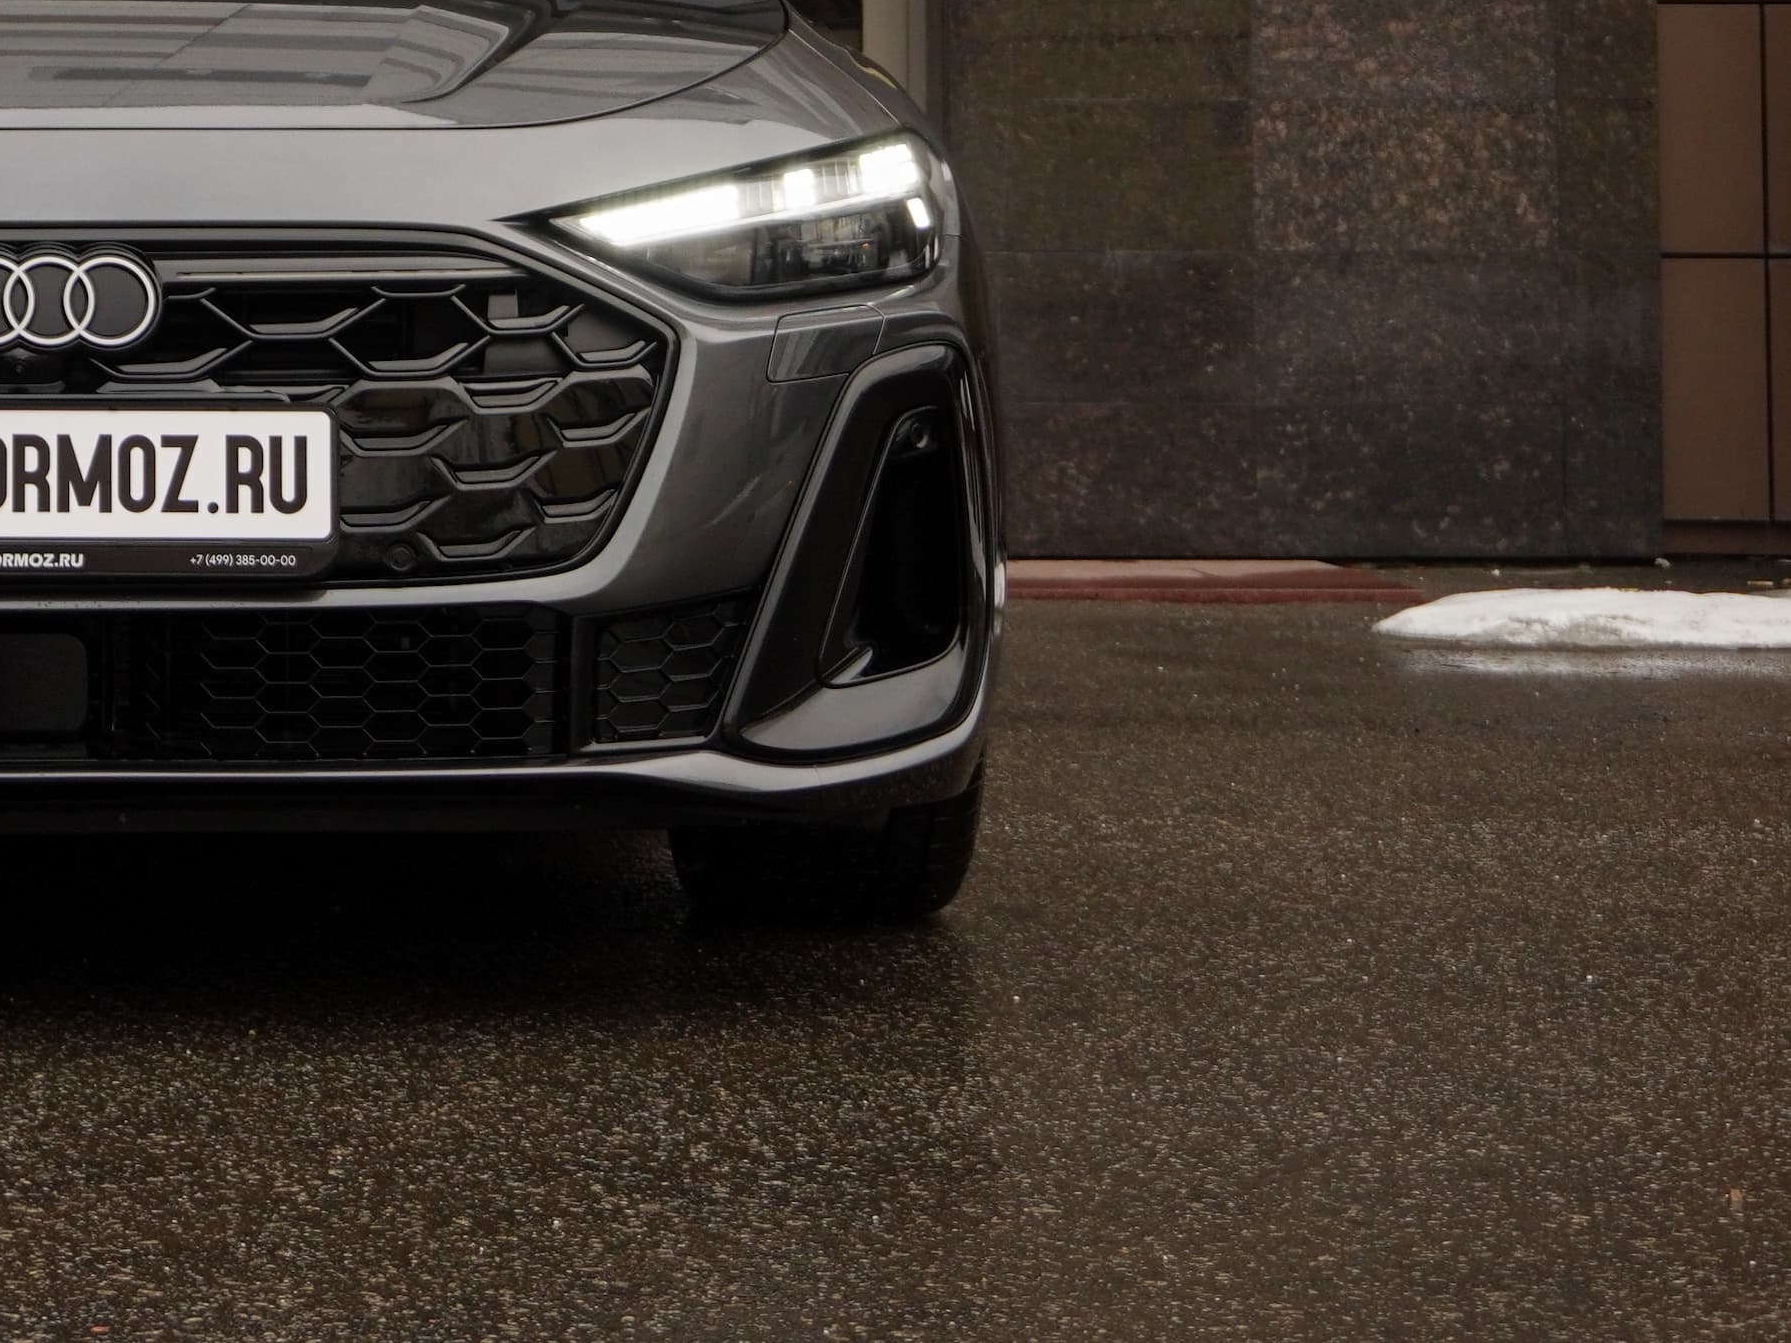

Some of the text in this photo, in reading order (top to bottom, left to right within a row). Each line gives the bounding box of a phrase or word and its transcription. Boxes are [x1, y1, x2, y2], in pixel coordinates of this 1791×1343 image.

[190, 553, 296, 567] +7 (499) 385-00-00
